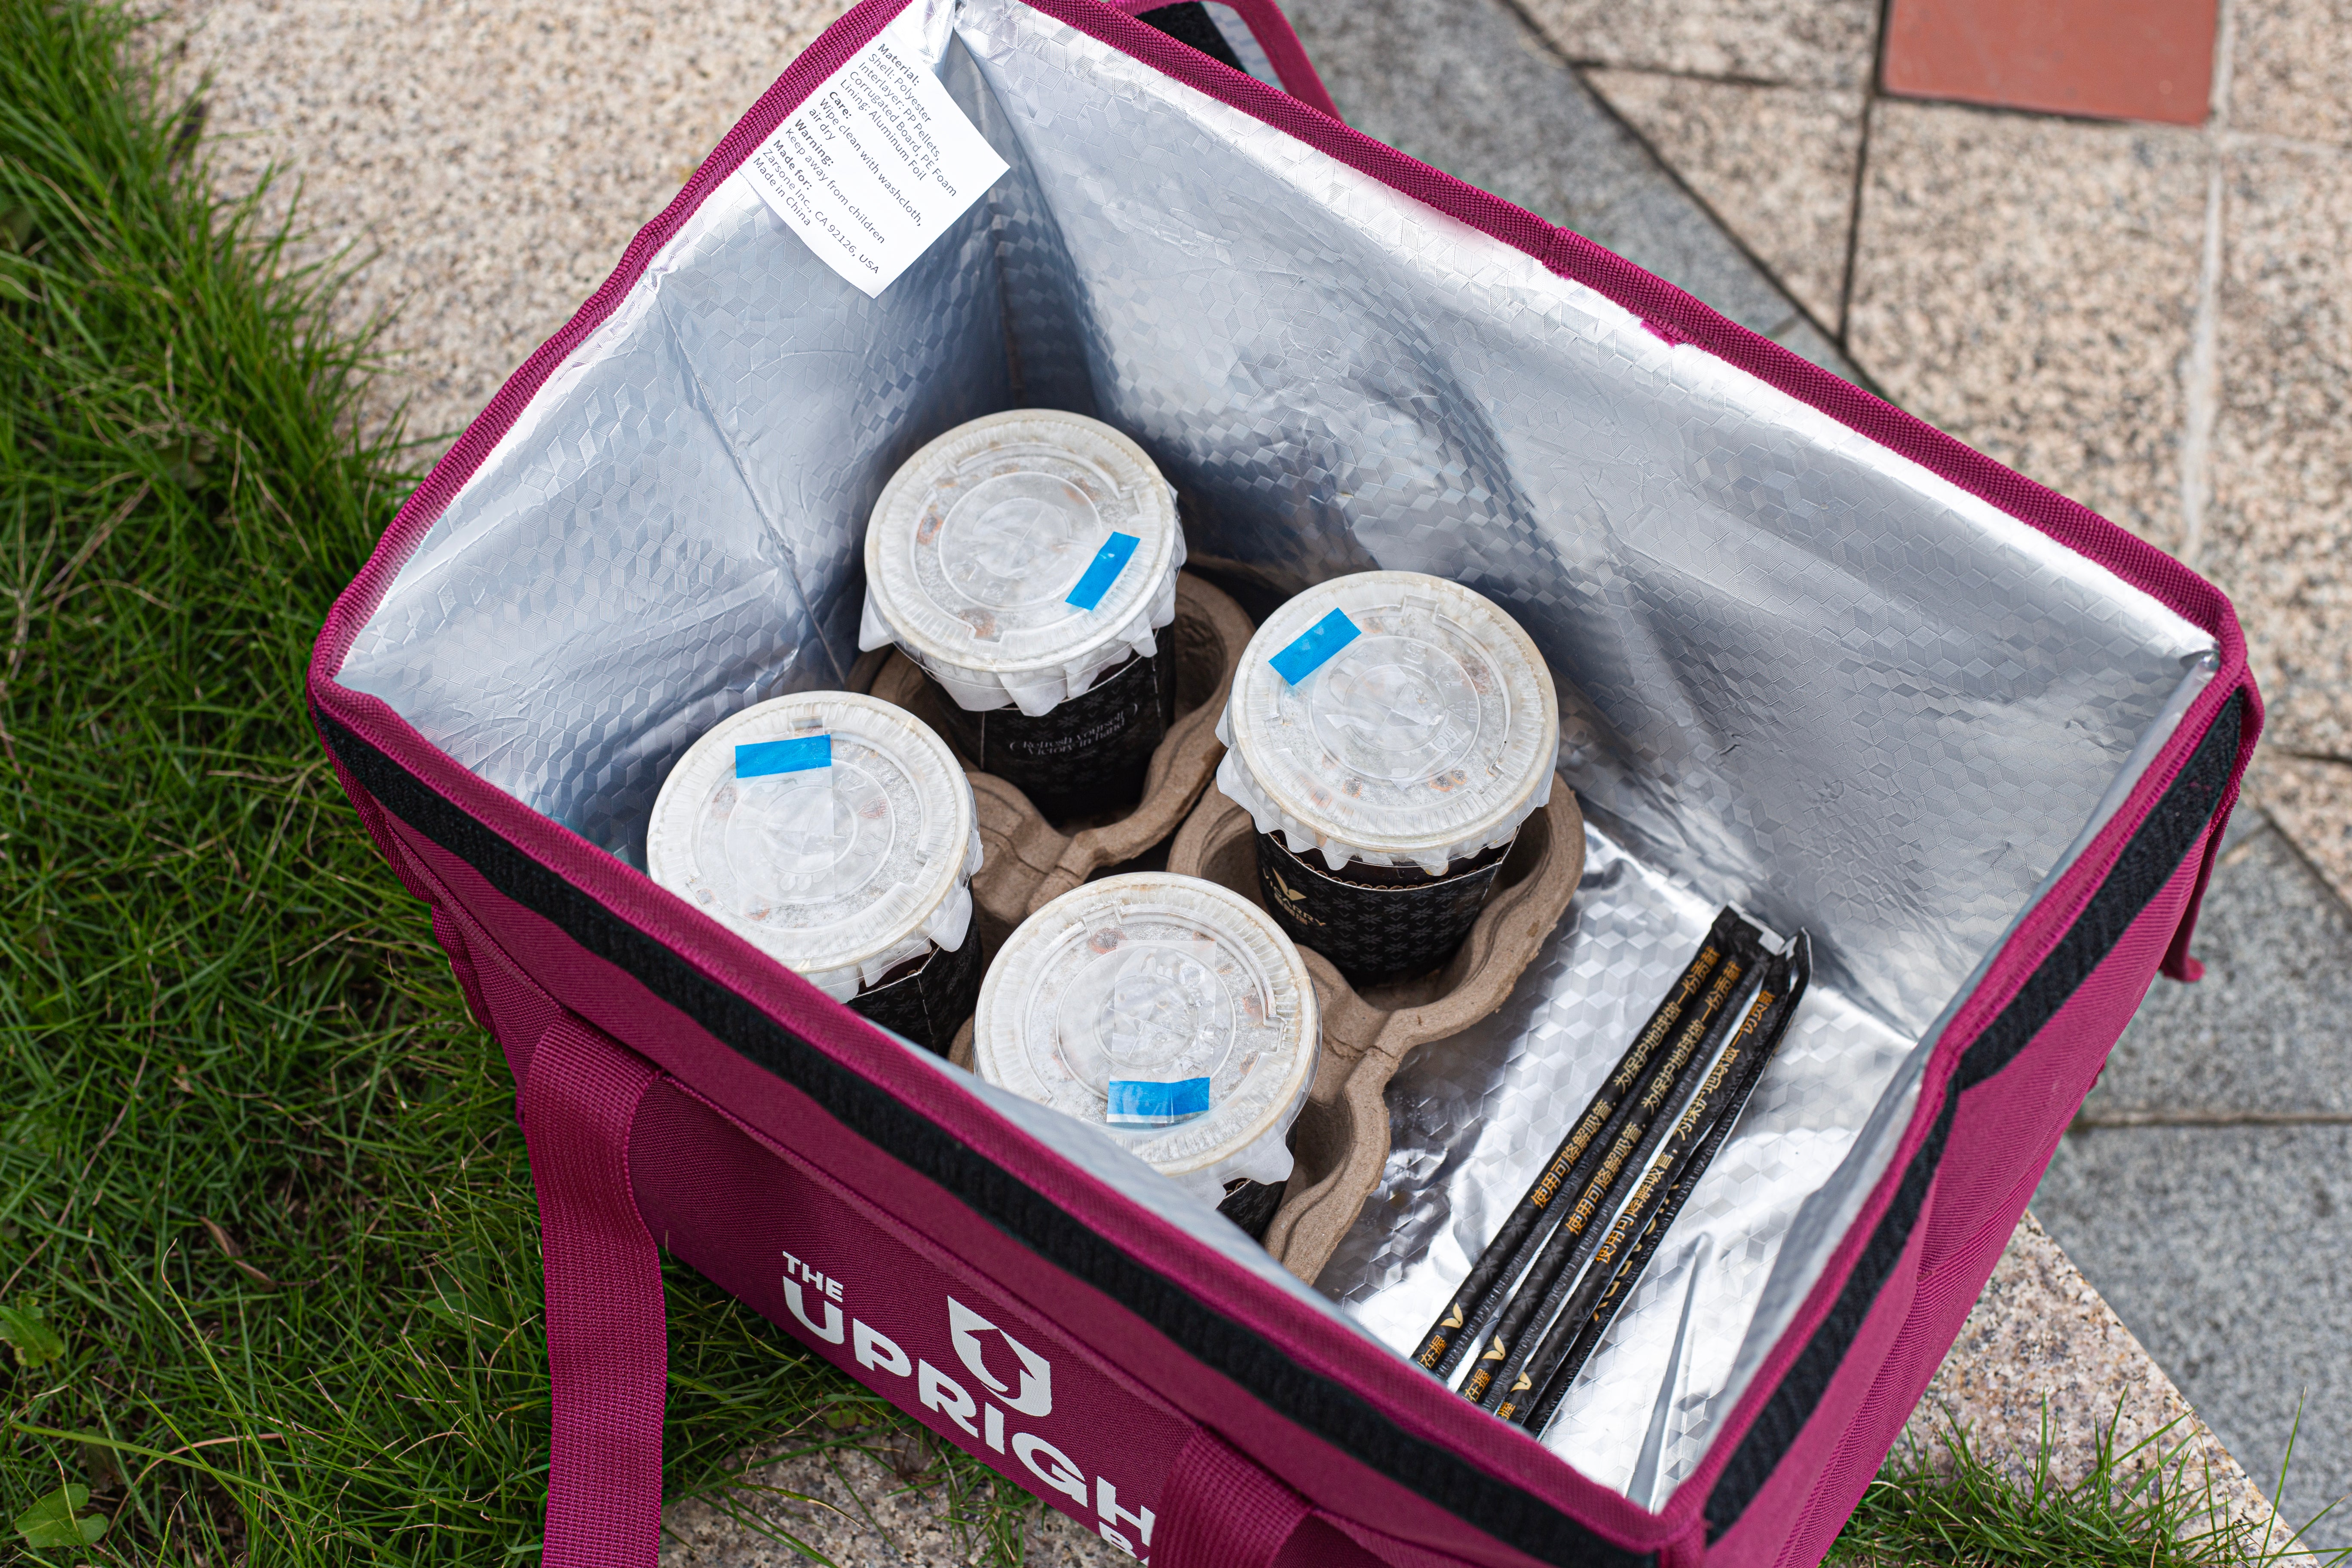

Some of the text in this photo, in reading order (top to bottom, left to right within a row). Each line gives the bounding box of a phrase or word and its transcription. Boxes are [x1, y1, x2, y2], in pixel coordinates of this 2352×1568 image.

[868, 54, 931, 122] Shell: Polyester
[878, 43, 919, 86] Material:
[809, 109, 836, 140] air dry
[829, 92, 852, 119] Care:
[840, 79, 927, 181] Lining: Aluminum Foil
[850, 71, 956, 197] Corrugated Board, PE Foam
[858, 62, 940, 161] Interlayer: PP Pellets,
[773, 139, 812, 190] Made for:
[795, 118, 834, 167] Warning:
[820, 98, 921, 227] Wipe clean with washcloth,
[753, 157, 811, 226] Made in China
[763, 148, 879, 274] Zarsone Inc., CA 92126, USA
[785, 128, 885, 244] Keep away from children
[782, 1251, 843, 1303] THE
[1417, 1334, 1448, 1372] 在握
[1461, 1368, 1491, 1404] 在握
[783, 1276, 1156, 1548] UPRIGH
